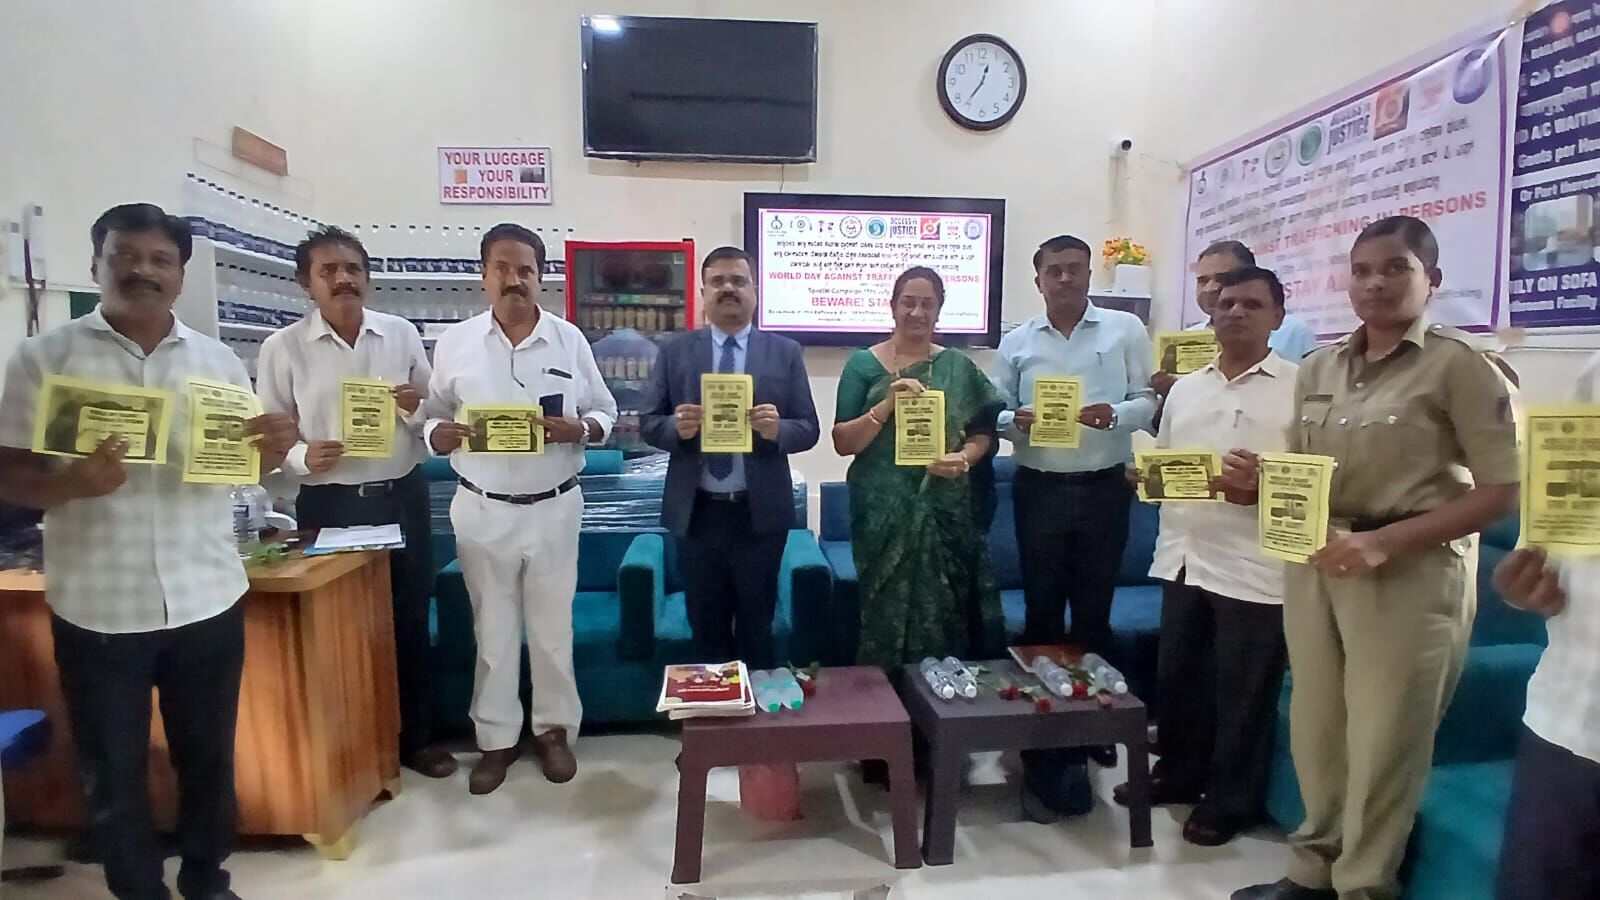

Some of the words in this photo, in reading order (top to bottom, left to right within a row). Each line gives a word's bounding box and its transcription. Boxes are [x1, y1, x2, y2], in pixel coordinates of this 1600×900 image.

[965, 53, 974, 63] 11
[977, 47, 987, 59] 12
[1003, 62, 1010, 73] 2
[1008, 77, 1014, 88] 3
[954, 93, 961, 103] 8
[978, 109, 985, 118] 6
[993, 102, 1000, 114] 5
[1327, 114, 1370, 155] JUSTICE
[445, 152, 480, 165] YOUR
[484, 152, 545, 166] LUGGAGE
[478, 169, 513, 182] YOUR
[443, 186, 549, 200] RESPONSIBILITY
[1285, 215, 1370, 249] TRAFFICKING
[1400, 190, 1487, 219] PERSONS
[890, 226, 918, 238] JUSTICE
[769, 272, 801, 280] WORLD
[824, 273, 862, 281] AGAINST
[865, 273, 897, 281] TRAFFI
[944, 275, 980, 283] ERSONS
[1537, 275, 1558, 292] ON
[1561, 271, 1597, 290] SOFA
[811, 297, 865, 307] BEWARE!
[868, 297, 891, 307] STA
